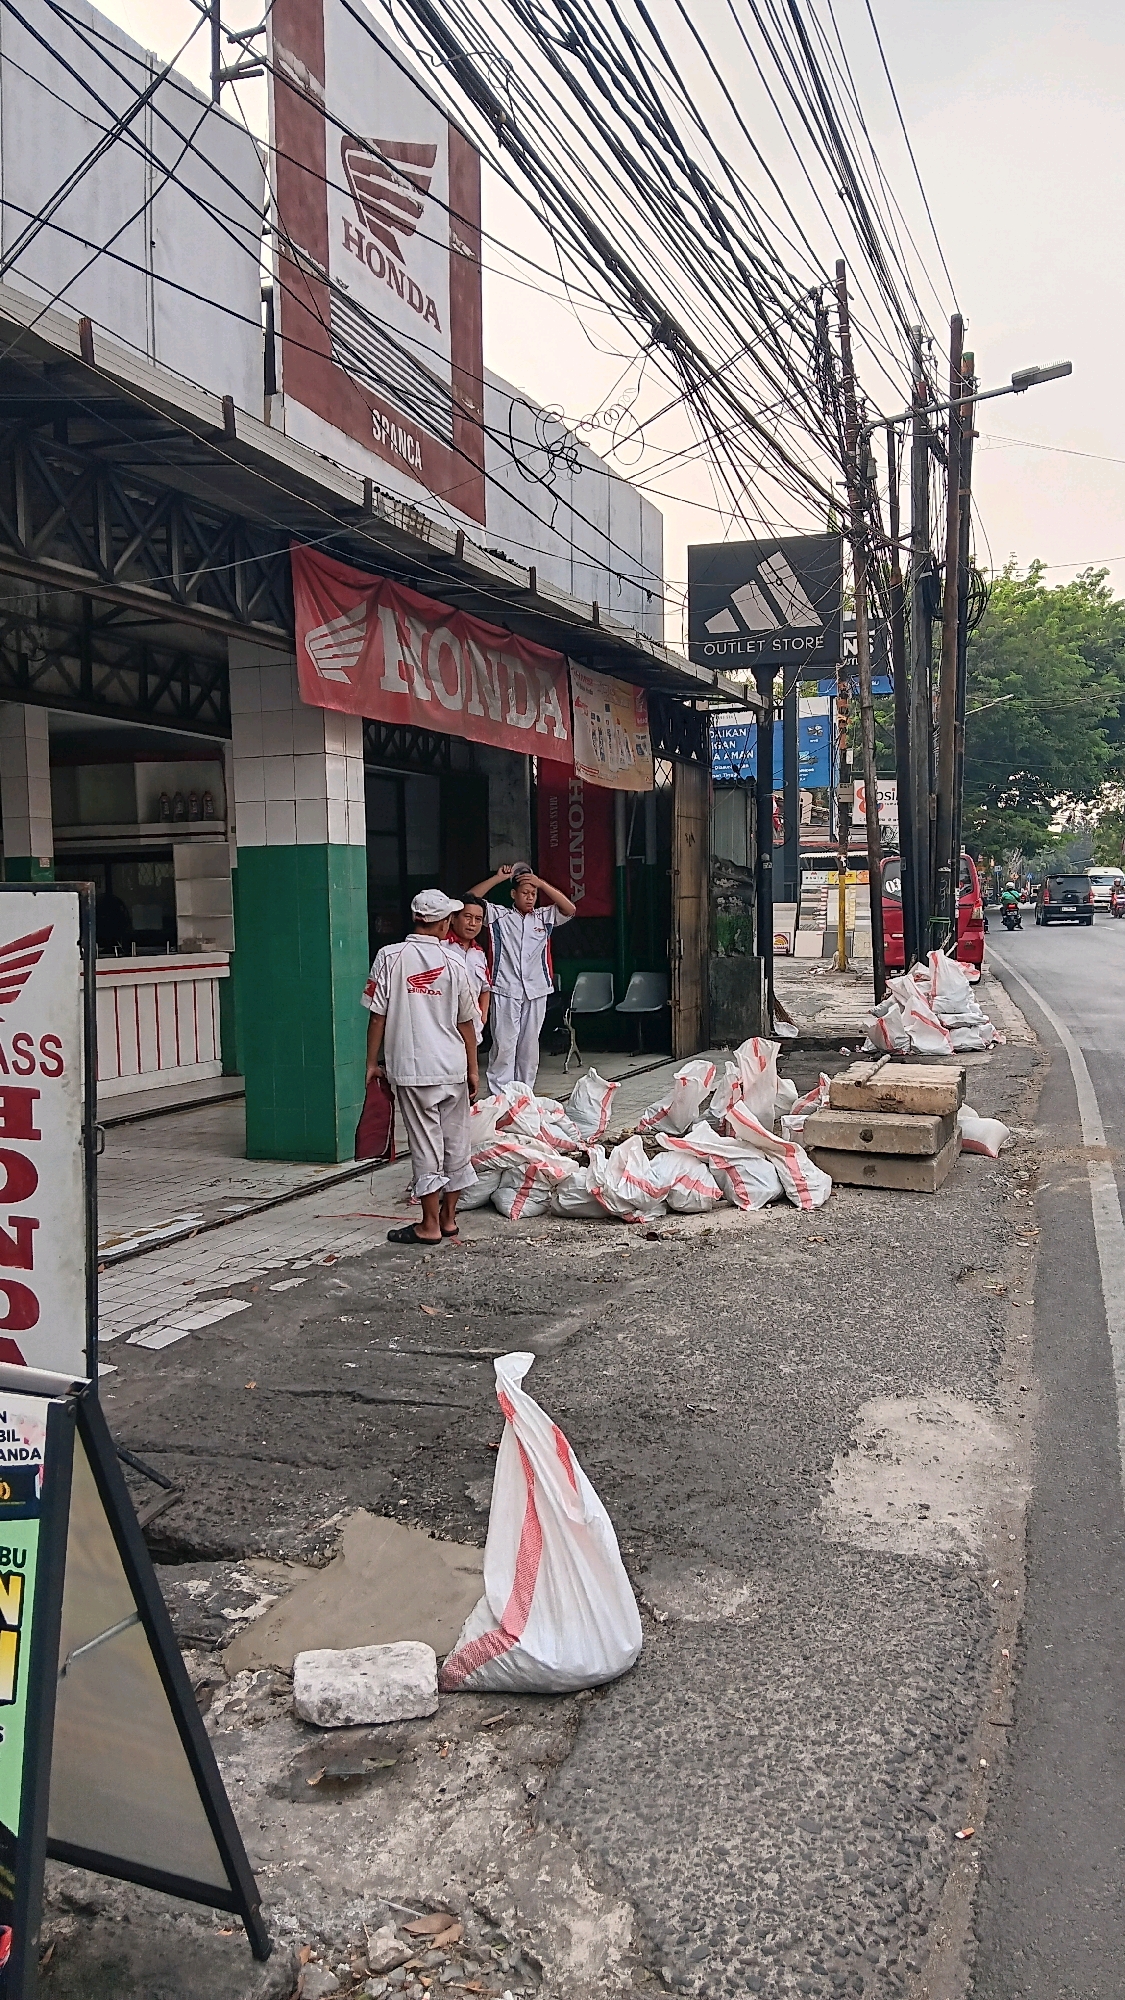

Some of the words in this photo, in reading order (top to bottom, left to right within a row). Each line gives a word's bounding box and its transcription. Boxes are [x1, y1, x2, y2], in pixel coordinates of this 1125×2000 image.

[342, 215, 442, 334] HONDA
[372, 408, 423, 471] SPANCA
[377, 603, 567, 741] HONDA
[703, 640, 766, 656] OUTLET
[772, 635, 825, 651] STORE
[568, 777, 587, 903] HONDA
